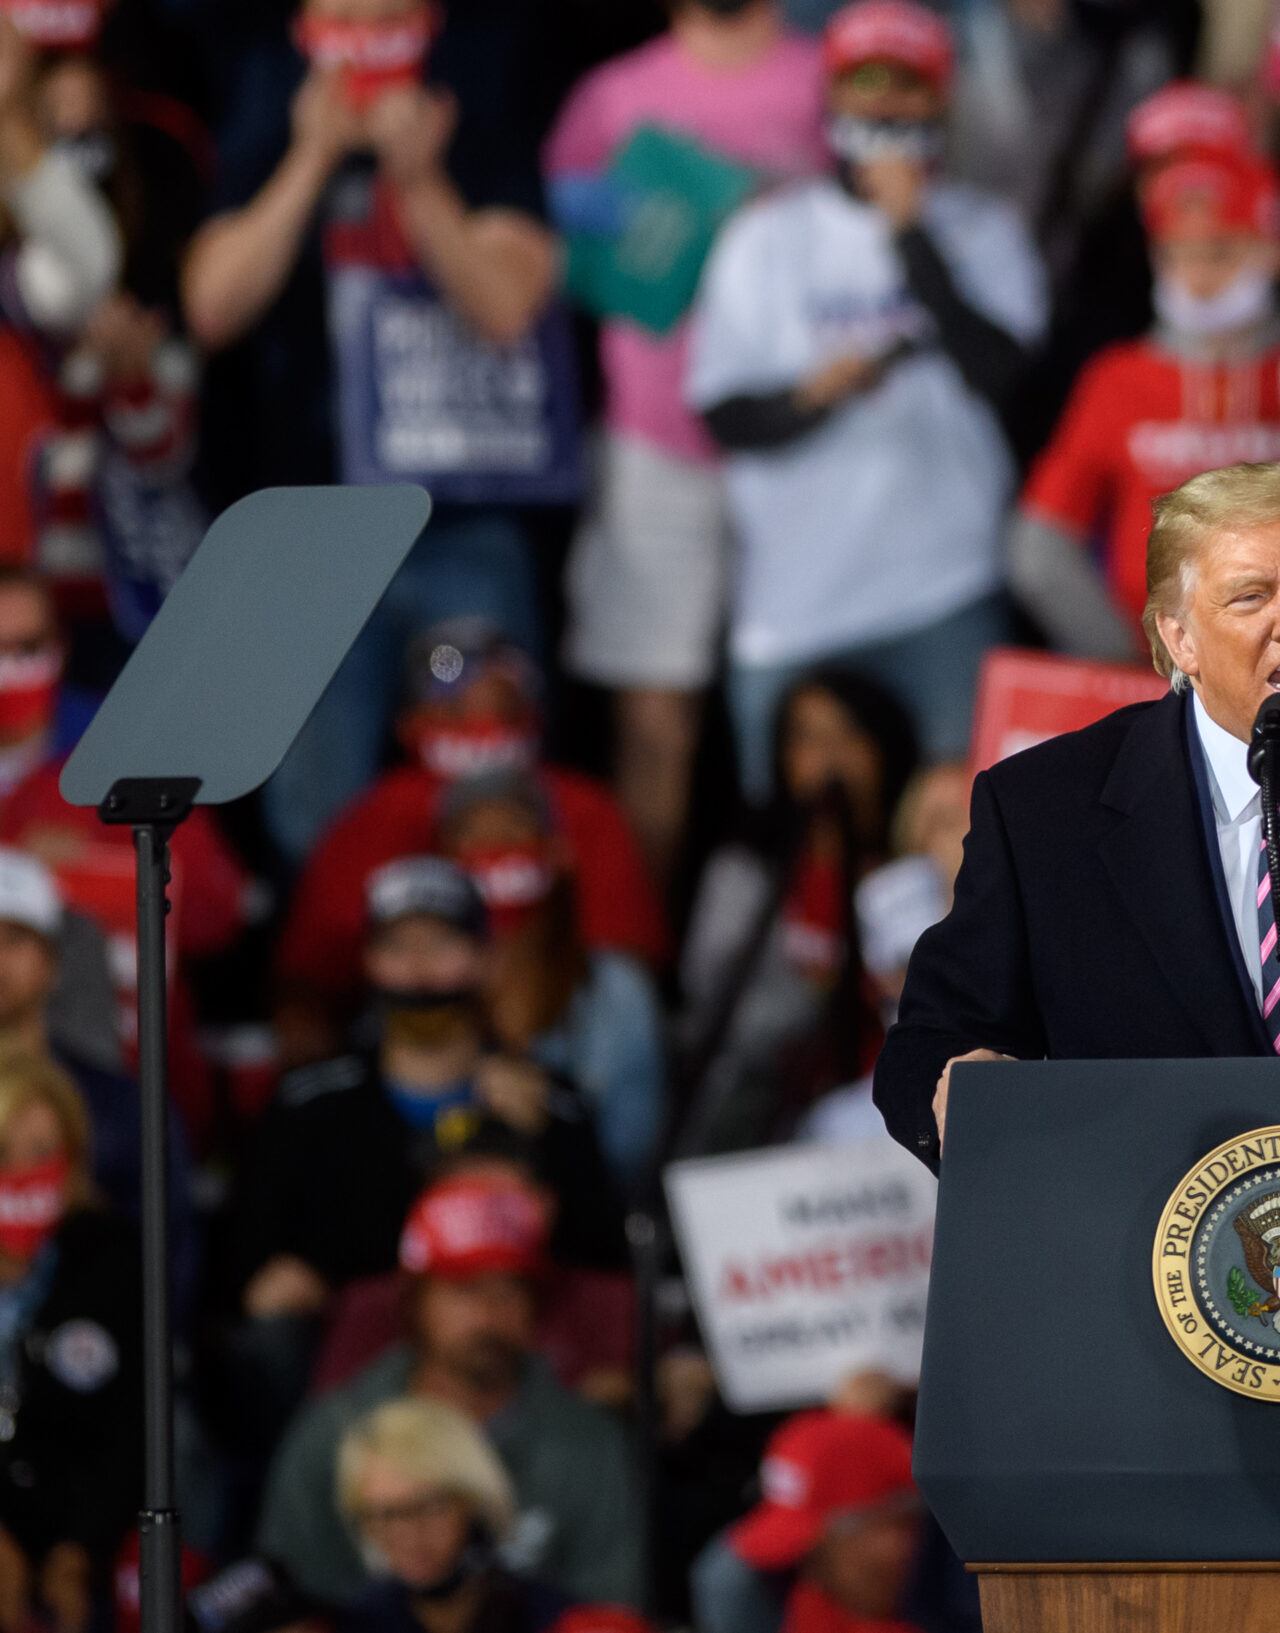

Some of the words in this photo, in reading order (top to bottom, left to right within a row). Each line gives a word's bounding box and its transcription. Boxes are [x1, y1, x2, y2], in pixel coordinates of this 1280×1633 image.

[1167, 1270, 1189, 1307] THE
[1177, 1312, 1197, 1334] OF
[1198, 1332, 1266, 1388] SEAL
